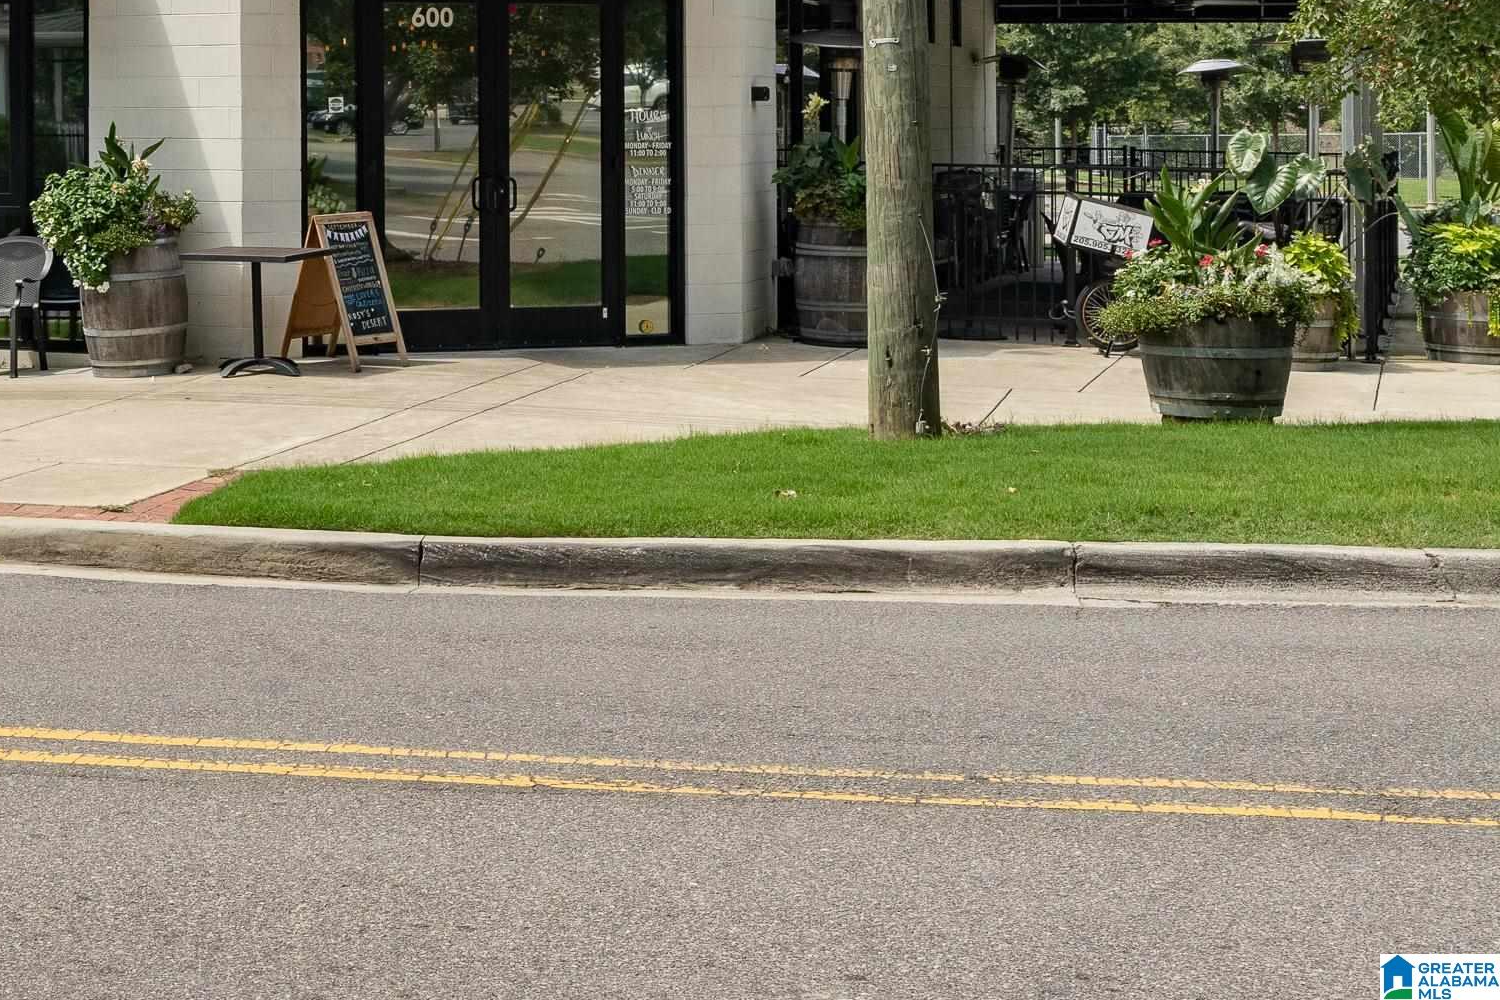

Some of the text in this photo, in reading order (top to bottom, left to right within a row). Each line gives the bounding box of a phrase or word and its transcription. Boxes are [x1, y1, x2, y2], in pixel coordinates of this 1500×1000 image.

[411, 7, 454, 27] 600
[624, 141, 649, 149] MONDAY
[652, 141, 672, 149] FRIDAY
[631, 166, 664, 177] DINNER
